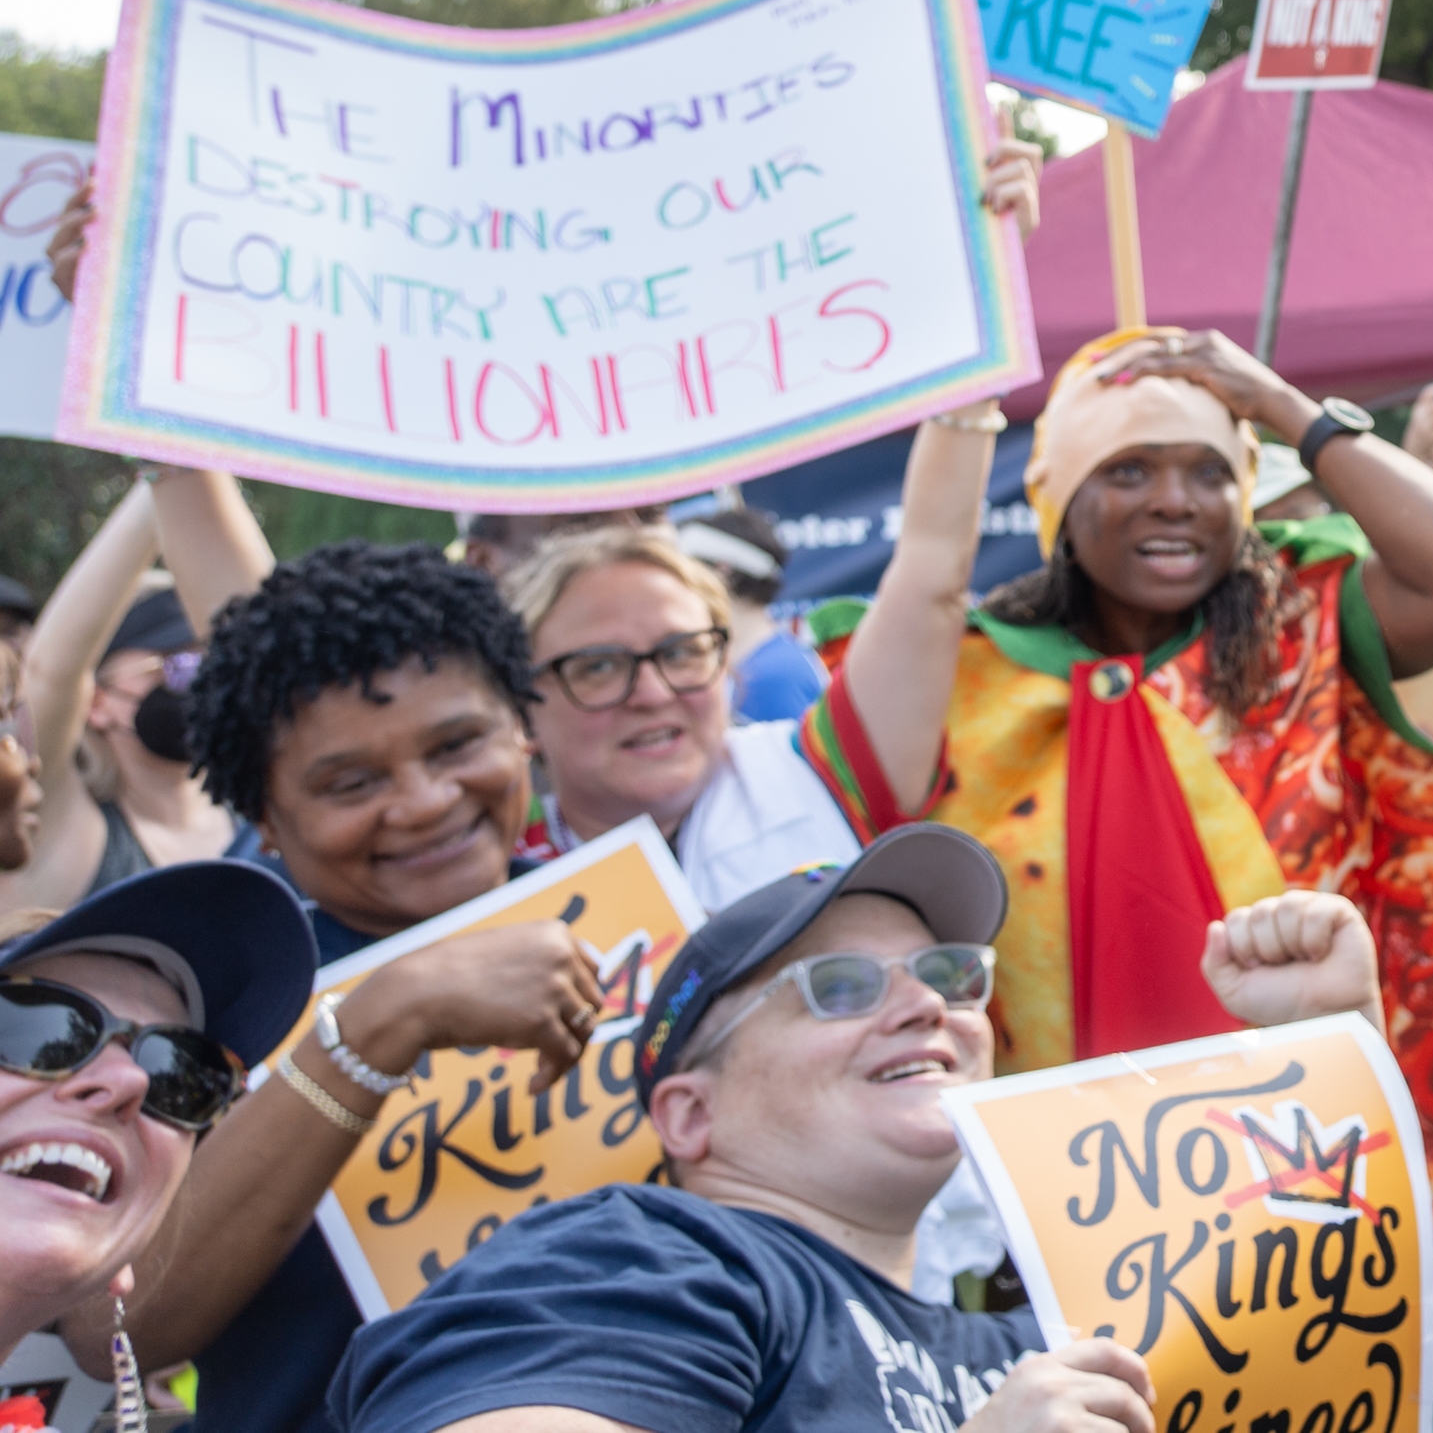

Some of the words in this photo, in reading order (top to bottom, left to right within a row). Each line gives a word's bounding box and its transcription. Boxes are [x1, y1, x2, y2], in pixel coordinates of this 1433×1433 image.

[200, 13, 394, 166] THE
[656, 144, 825, 231] OUR
[173, 211, 507, 342] COUNTRY
[542, 265, 694, 338] ARE
[725, 212, 857, 294] THE
[174, 278, 893, 446] BILLIONAIRES
[366, 1032, 648, 1228] King
[1066, 1059, 1306, 1228] No
[1094, 1205, 1410, 1375] Kings
